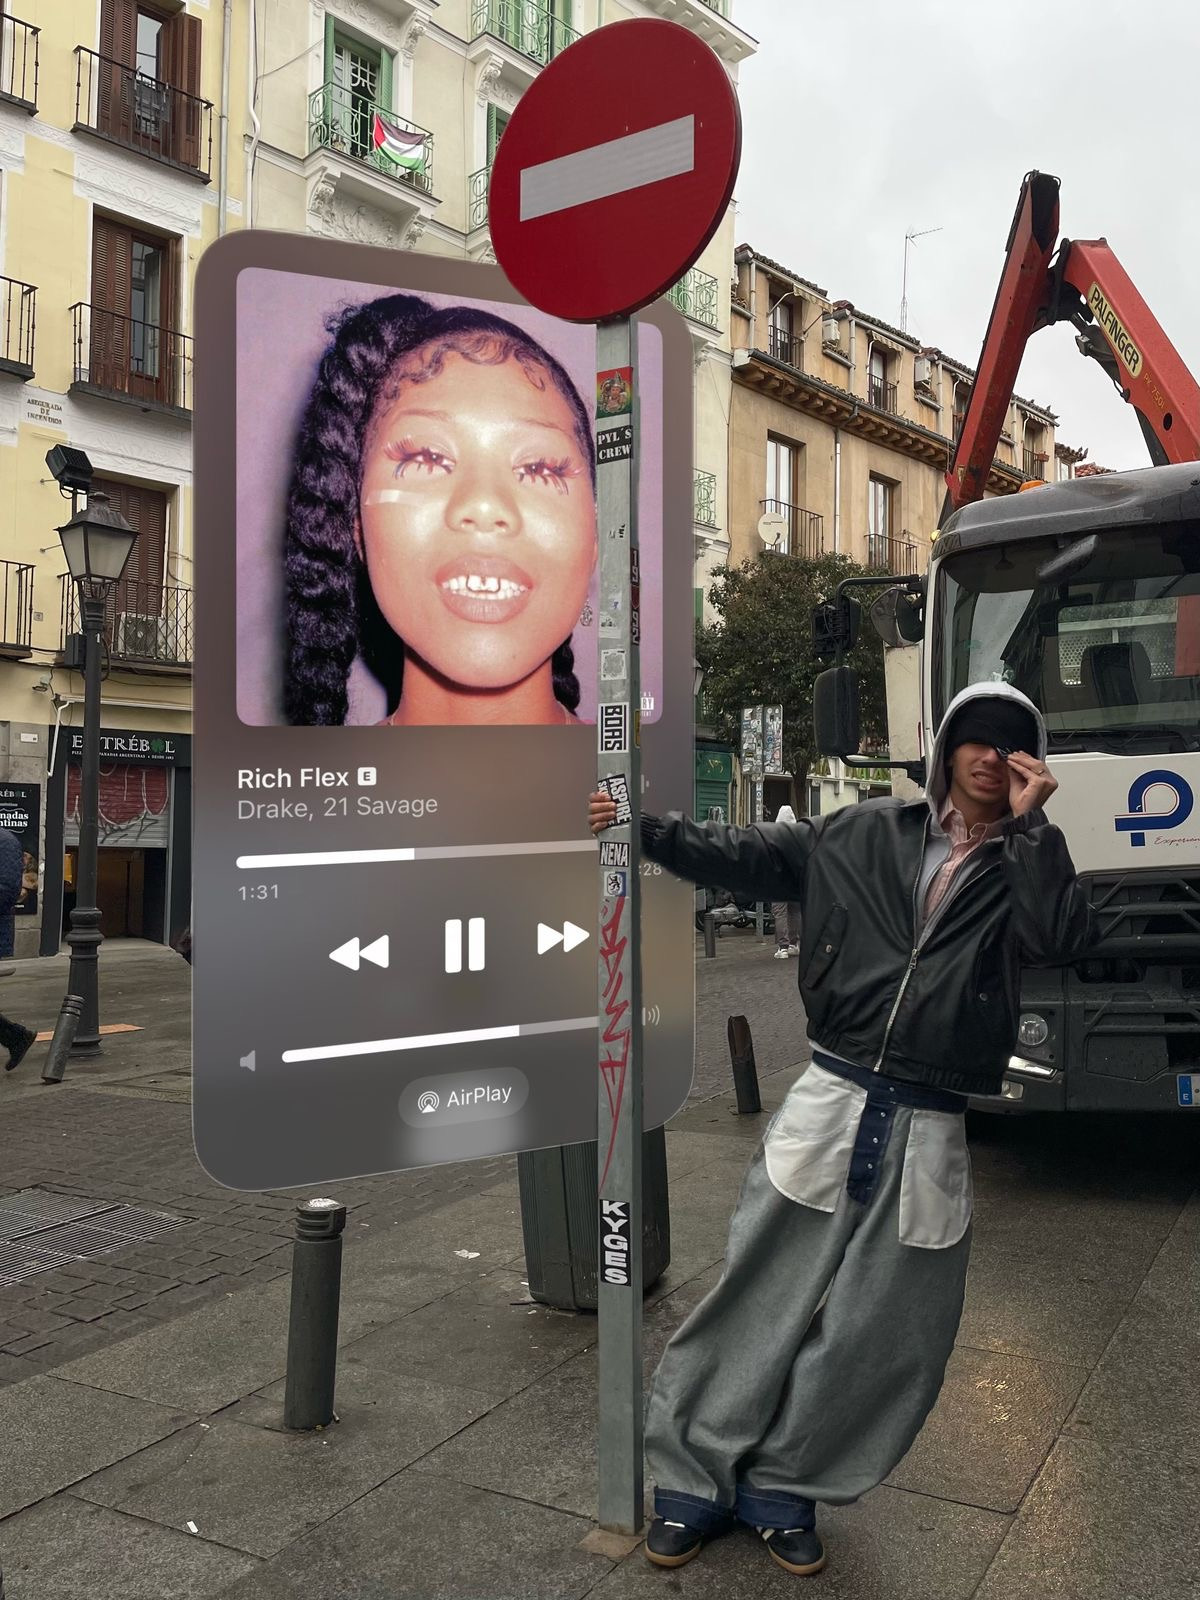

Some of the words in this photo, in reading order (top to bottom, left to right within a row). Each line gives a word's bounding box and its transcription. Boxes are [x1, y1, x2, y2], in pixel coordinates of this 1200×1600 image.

[1090, 287, 1139, 373] PALFINGER
[40, 407, 50, 415] DE
[598, 444, 632, 460] CREW
[604, 705, 623, 751] BOAS
[72, 734, 83, 748] E
[100, 734, 175, 753] TRÉBL
[608, 777, 632, 824] ASPIRE
[0, 811, 29, 820] nadas
[0, 819, 28, 827] ntinas
[600, 842, 629, 866] NENA
[1182, 1093, 1189, 1101] E
[602, 1200, 628, 1285] KYGES
